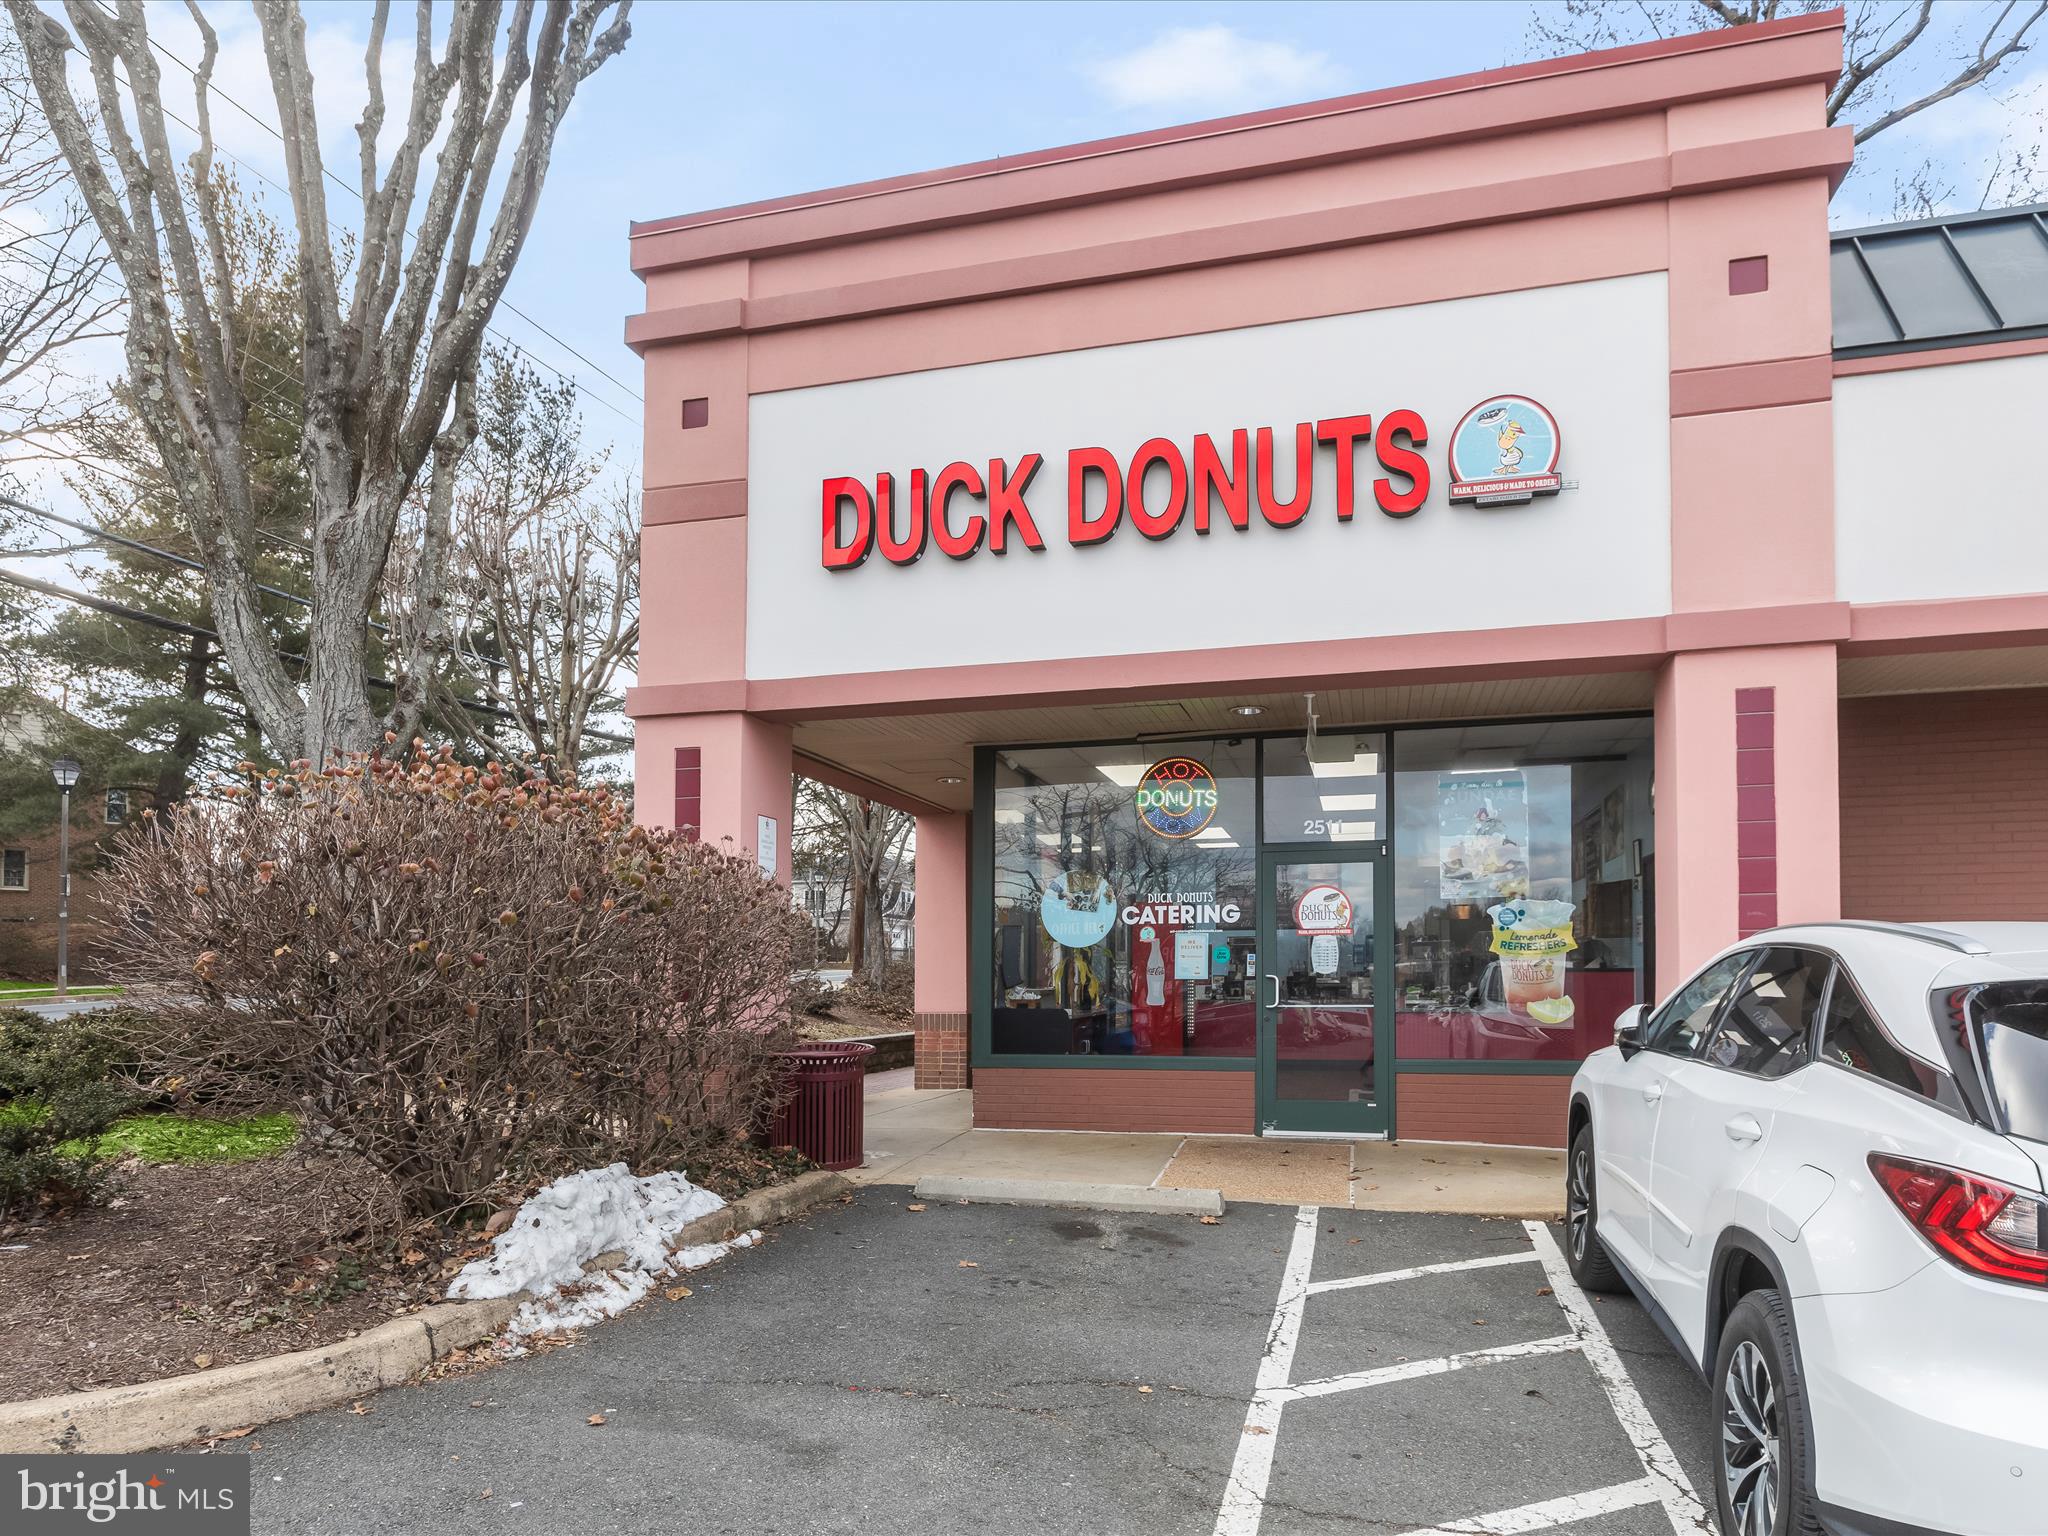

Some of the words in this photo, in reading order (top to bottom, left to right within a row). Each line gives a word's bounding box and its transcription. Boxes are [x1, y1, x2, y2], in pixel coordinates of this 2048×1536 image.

[822, 453, 1047, 572] DUCK
[1068, 409, 1431, 547] DONUTS
[1453, 486, 1473, 495] WARM,
[1473, 482, 1503, 493] DELICIOUS
[1509, 481, 1527, 489] MADE
[1154, 763, 1204, 785] HOT
[1138, 789, 1218, 807] DONUTS
[1148, 807, 1202, 833] NOW
[1303, 819, 1343, 834] 2511
[1147, 892, 1173, 903] DUCK
[1177, 891, 1214, 903] DONUTS
[1121, 904, 1241, 925] CATERING
[1302, 904, 1332, 912] DUCK
[1301, 911, 1340, 921] DONUTS
[1509, 929, 1558, 941] Lemonade
[1500, 939, 1567, 951] REFRESHERS
[1511, 959, 1533, 970] DUCK
[1512, 970, 1545, 981] DONUTS
